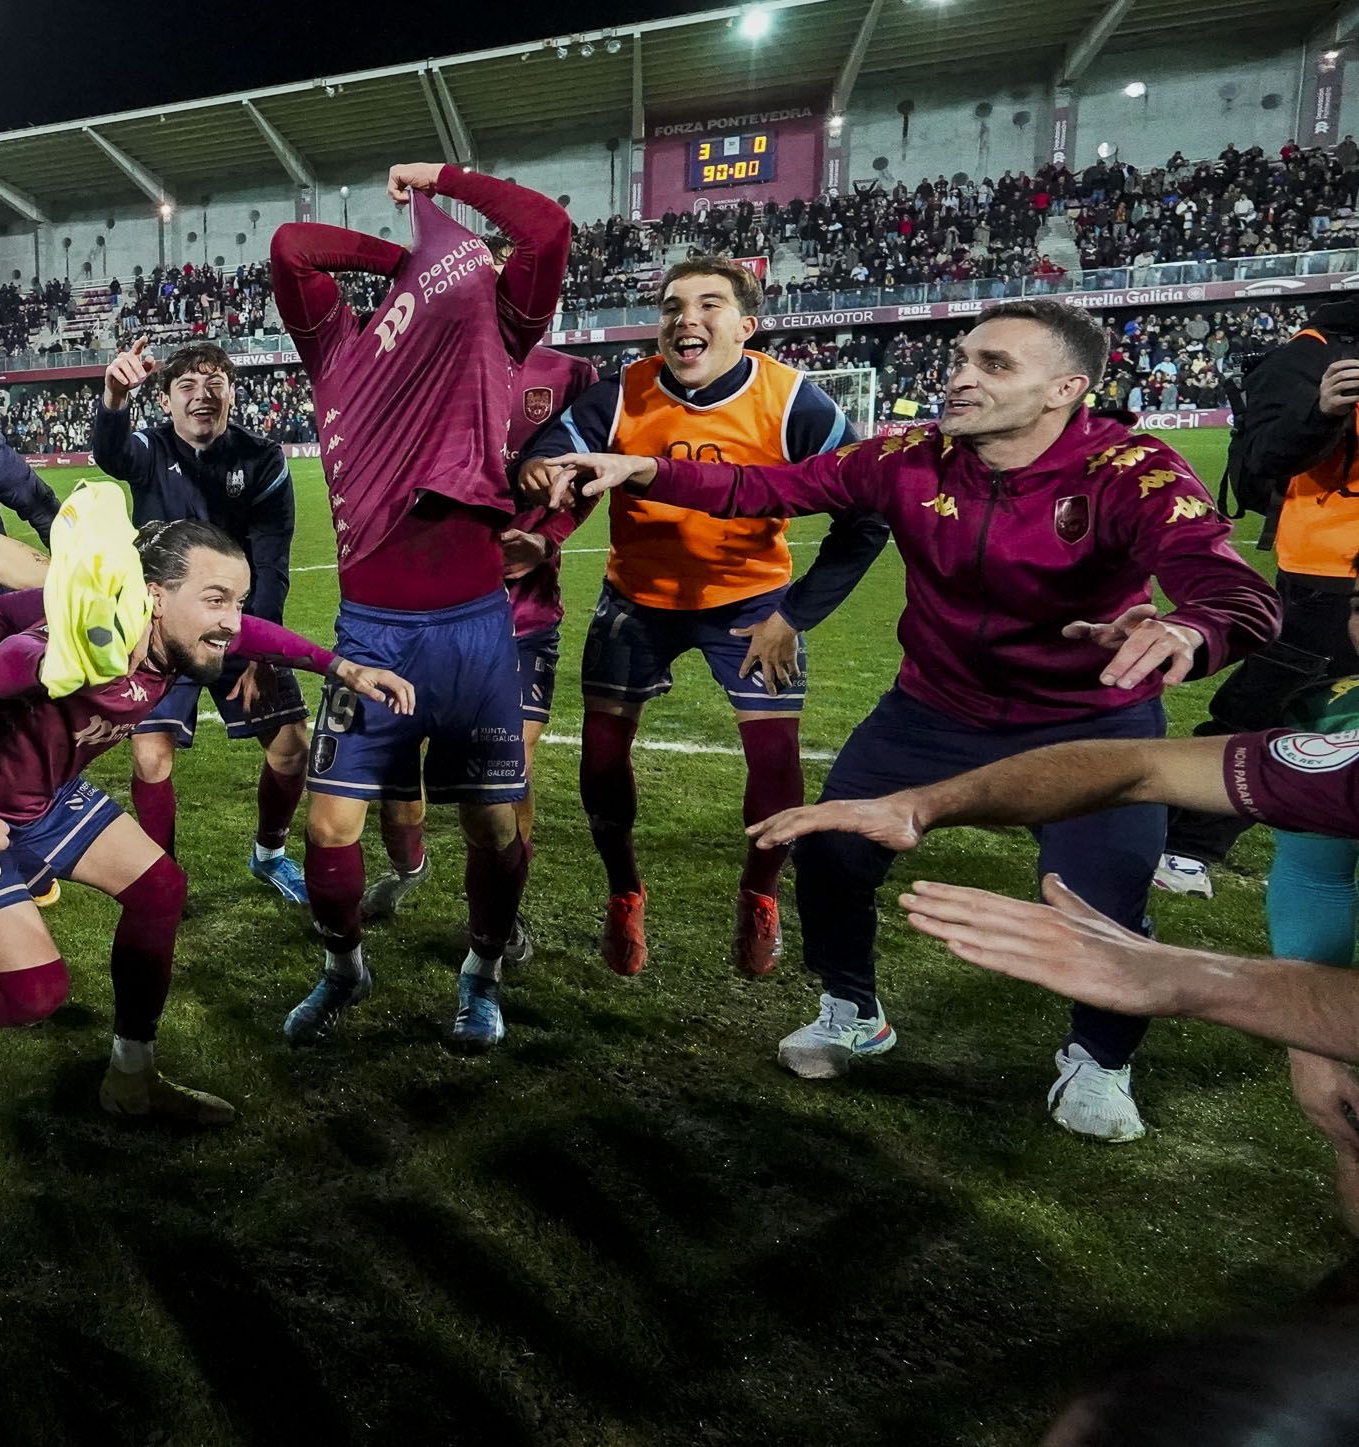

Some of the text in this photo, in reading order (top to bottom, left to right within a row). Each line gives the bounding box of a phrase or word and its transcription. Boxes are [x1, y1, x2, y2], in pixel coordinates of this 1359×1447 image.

[654, 106, 813, 137] FORZA PONTEVEDRA
[698, 143, 711, 161] 3
[753, 135, 767, 154] 0
[948, 302, 982, 313] FROIZ
[1064, 288, 1184, 308] Estrella Galicia
[782, 310, 874, 329] CELTAMOTOR
[898, 305, 932, 316] FROIZ
[317, 684, 358, 733] 19
[1233, 747, 1247, 768] NON
[486, 769, 516, 777] GALEGO
